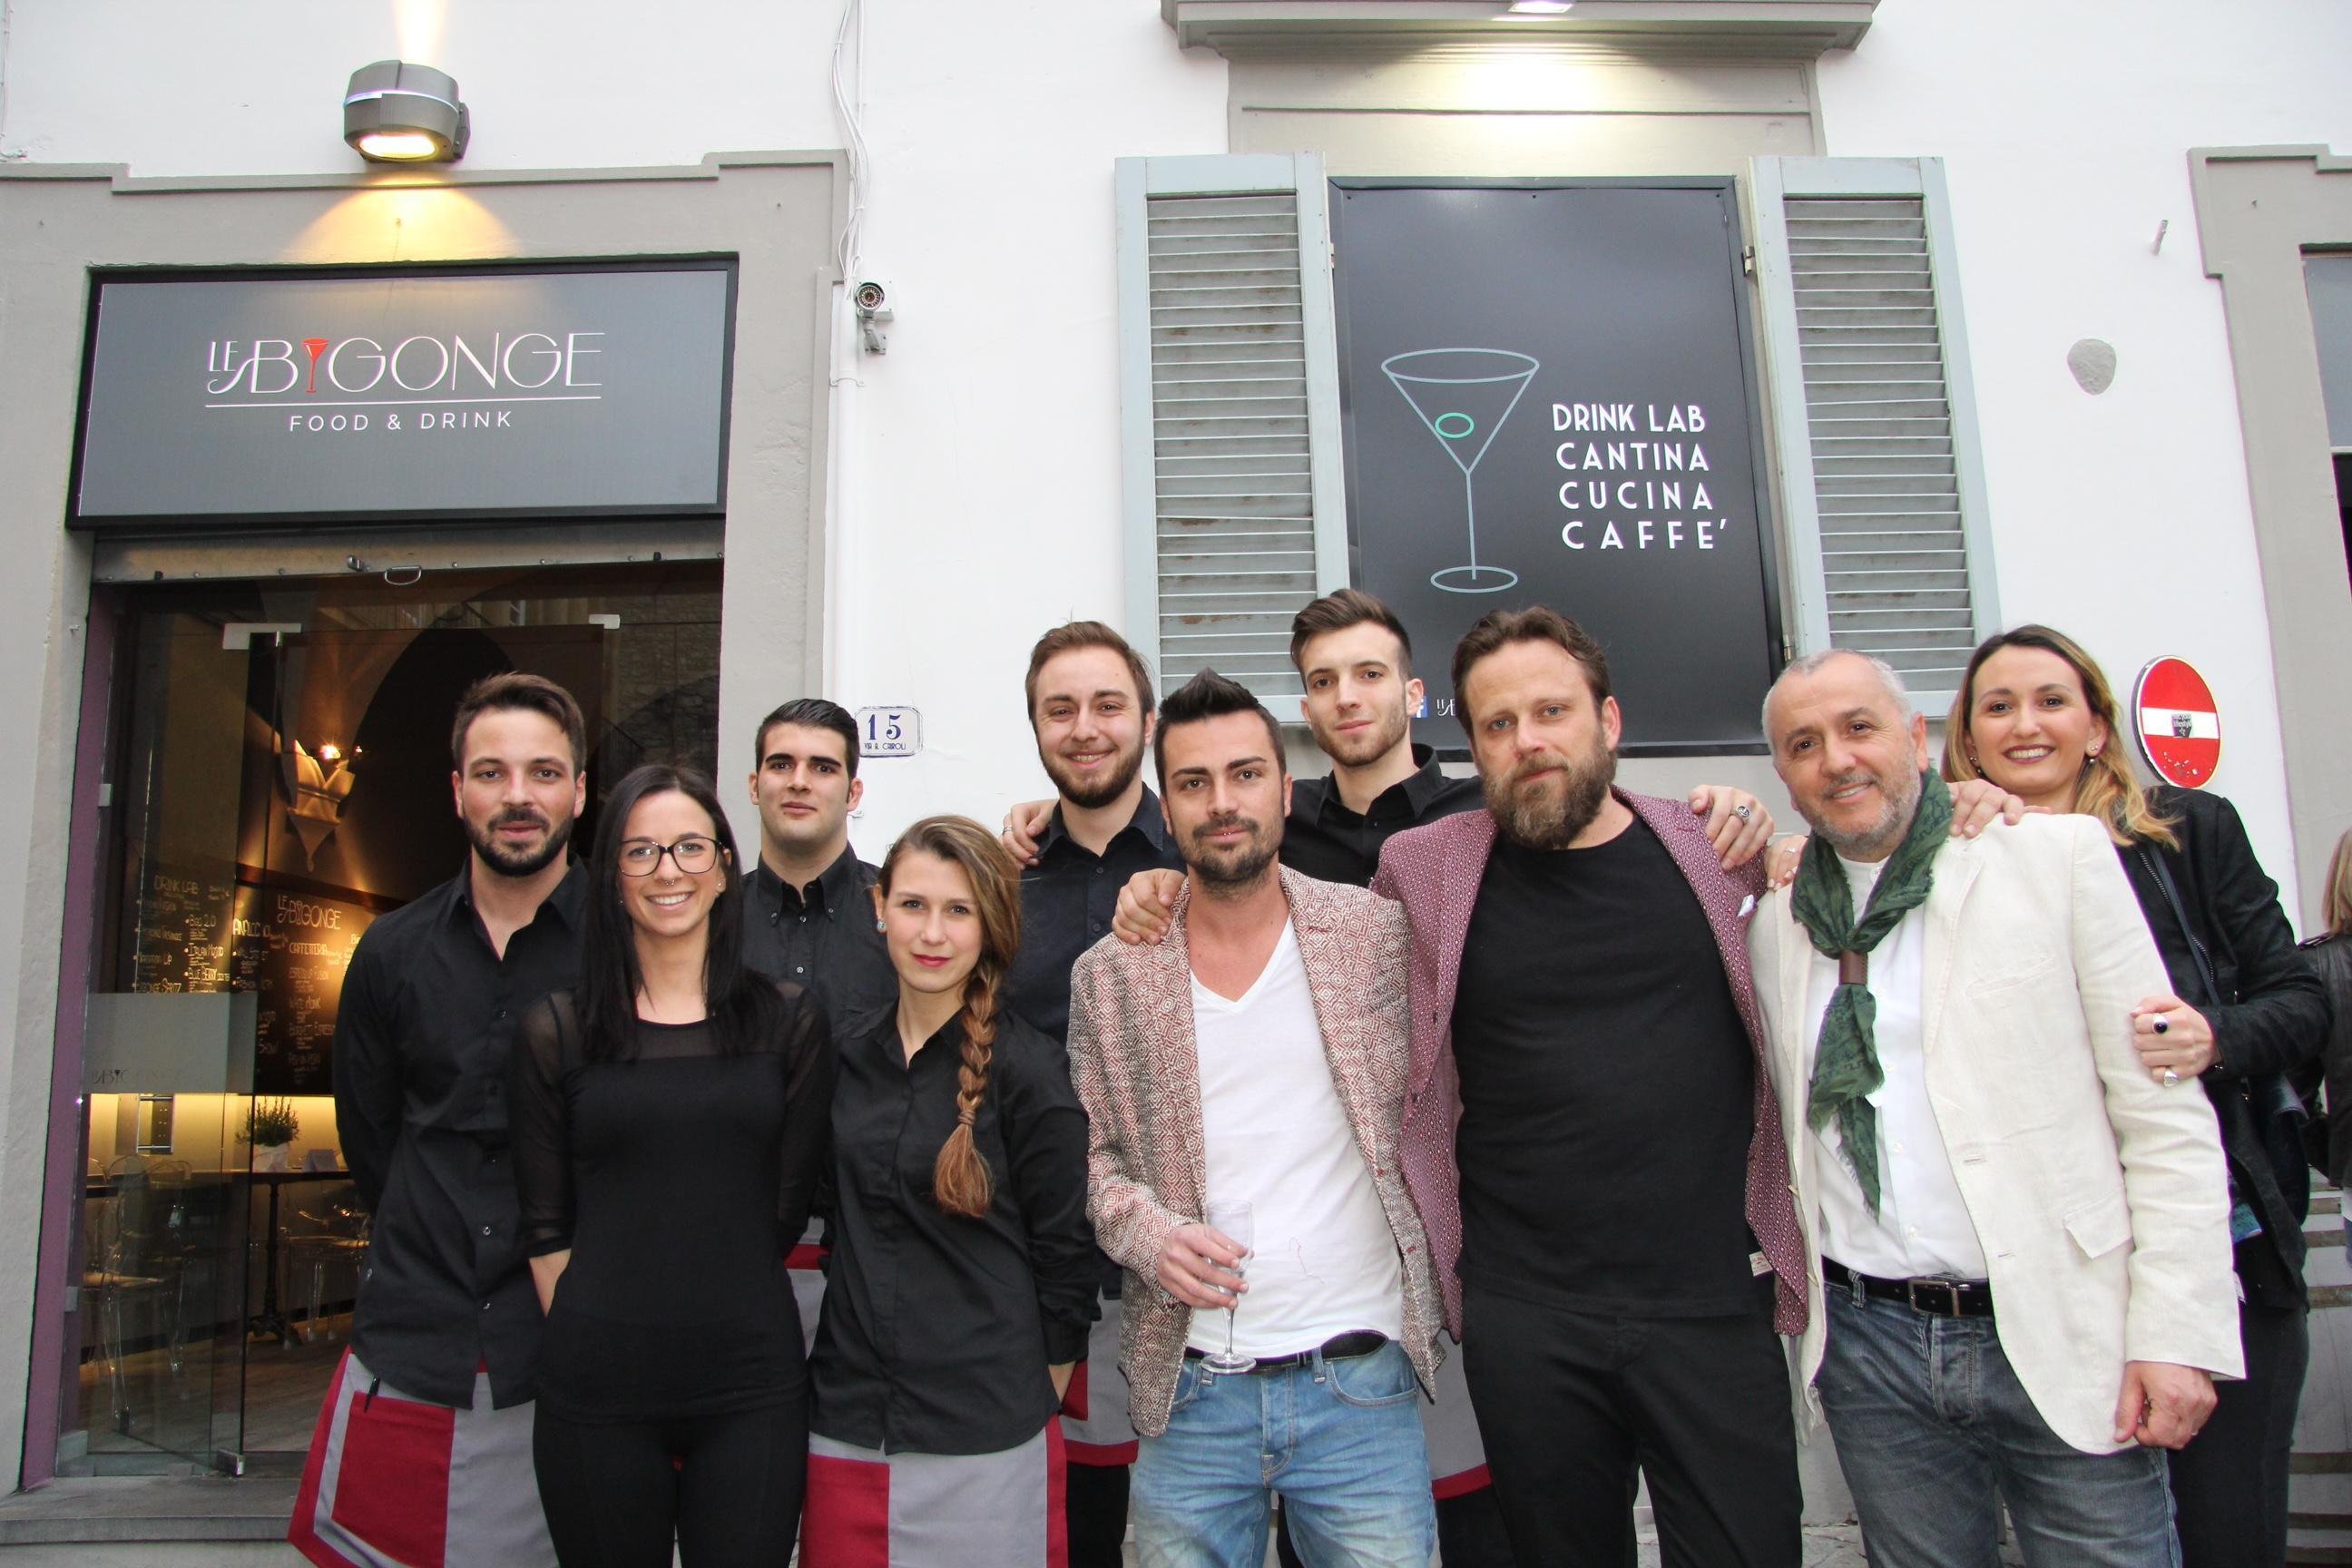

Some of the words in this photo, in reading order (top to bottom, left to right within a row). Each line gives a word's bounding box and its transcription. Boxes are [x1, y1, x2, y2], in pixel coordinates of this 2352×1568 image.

[207, 340, 239, 373] LE
[289, 414, 369, 433] FOOD
[387, 413, 402, 431] &
[420, 410, 514, 430] DRINK
[1552, 403, 1636, 432] DRINK
[1648, 404, 1706, 433] LAB
[1555, 442, 1710, 472] CANTINA
[1558, 481, 1713, 510] CUCINA
[1561, 518, 1727, 550] CAFFE'
[867, 713, 902, 740] 15
